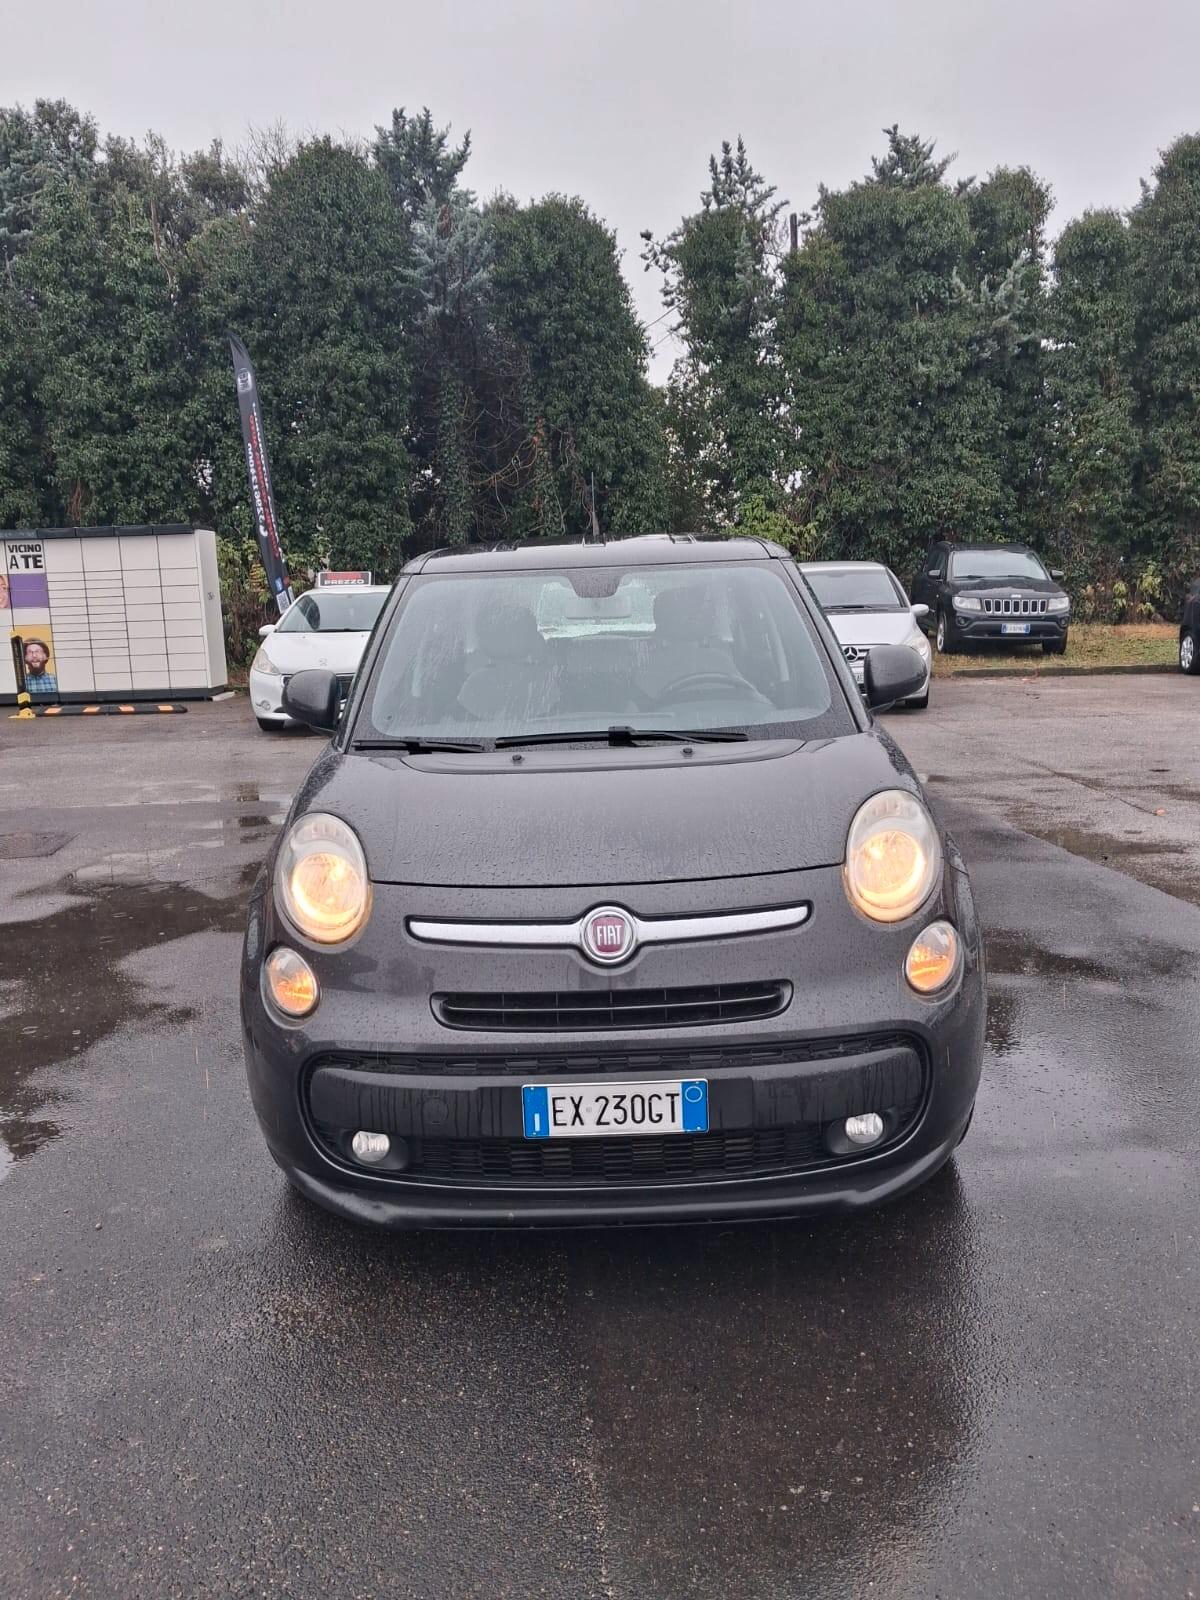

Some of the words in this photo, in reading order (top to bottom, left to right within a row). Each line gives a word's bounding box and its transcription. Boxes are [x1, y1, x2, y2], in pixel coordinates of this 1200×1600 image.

[7, 543, 42, 553] VICINO
[10, 555, 19, 569] A
[20, 554, 43, 569] TE
[596, 924, 622, 946] FIAT
[551, 1095, 584, 1126] EX
[594, 1092, 680, 1126] 230GT
